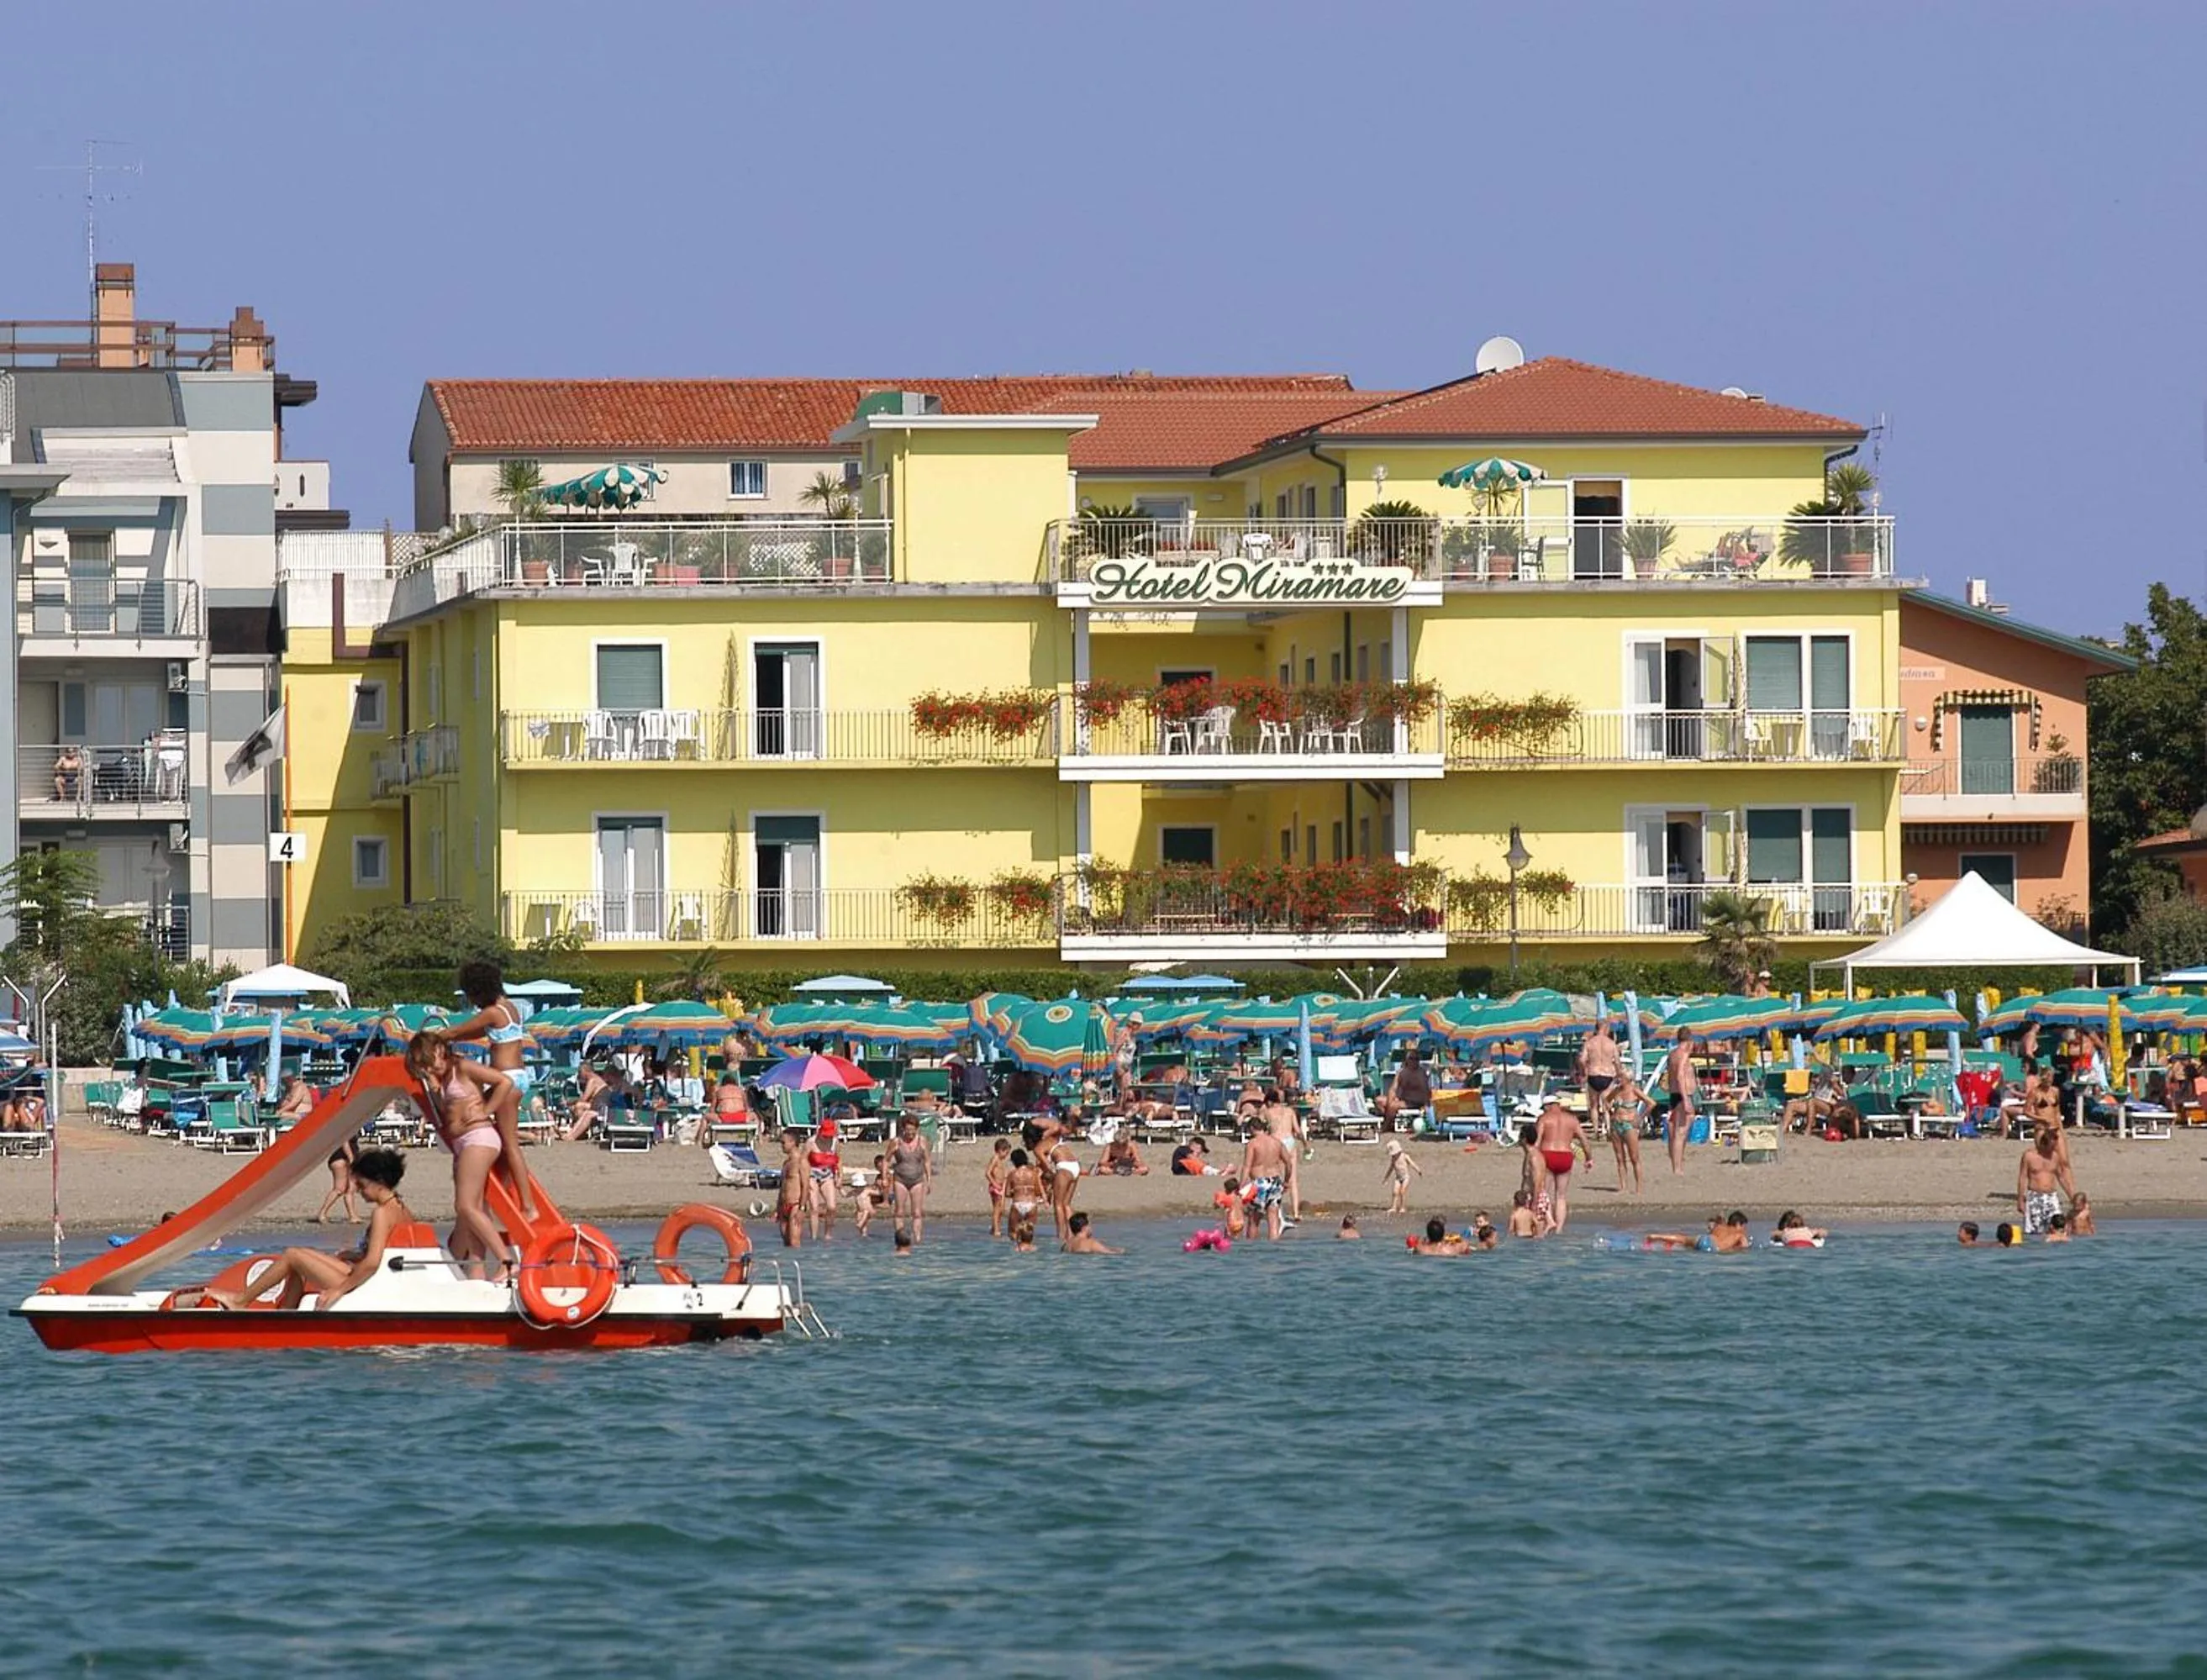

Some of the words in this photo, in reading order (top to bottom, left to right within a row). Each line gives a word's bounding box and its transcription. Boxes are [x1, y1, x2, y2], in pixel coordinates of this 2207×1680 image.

[1094, 561, 1212, 599] Hotel
[1215, 561, 1406, 599] Miramare
[280, 836, 294, 859] 4
